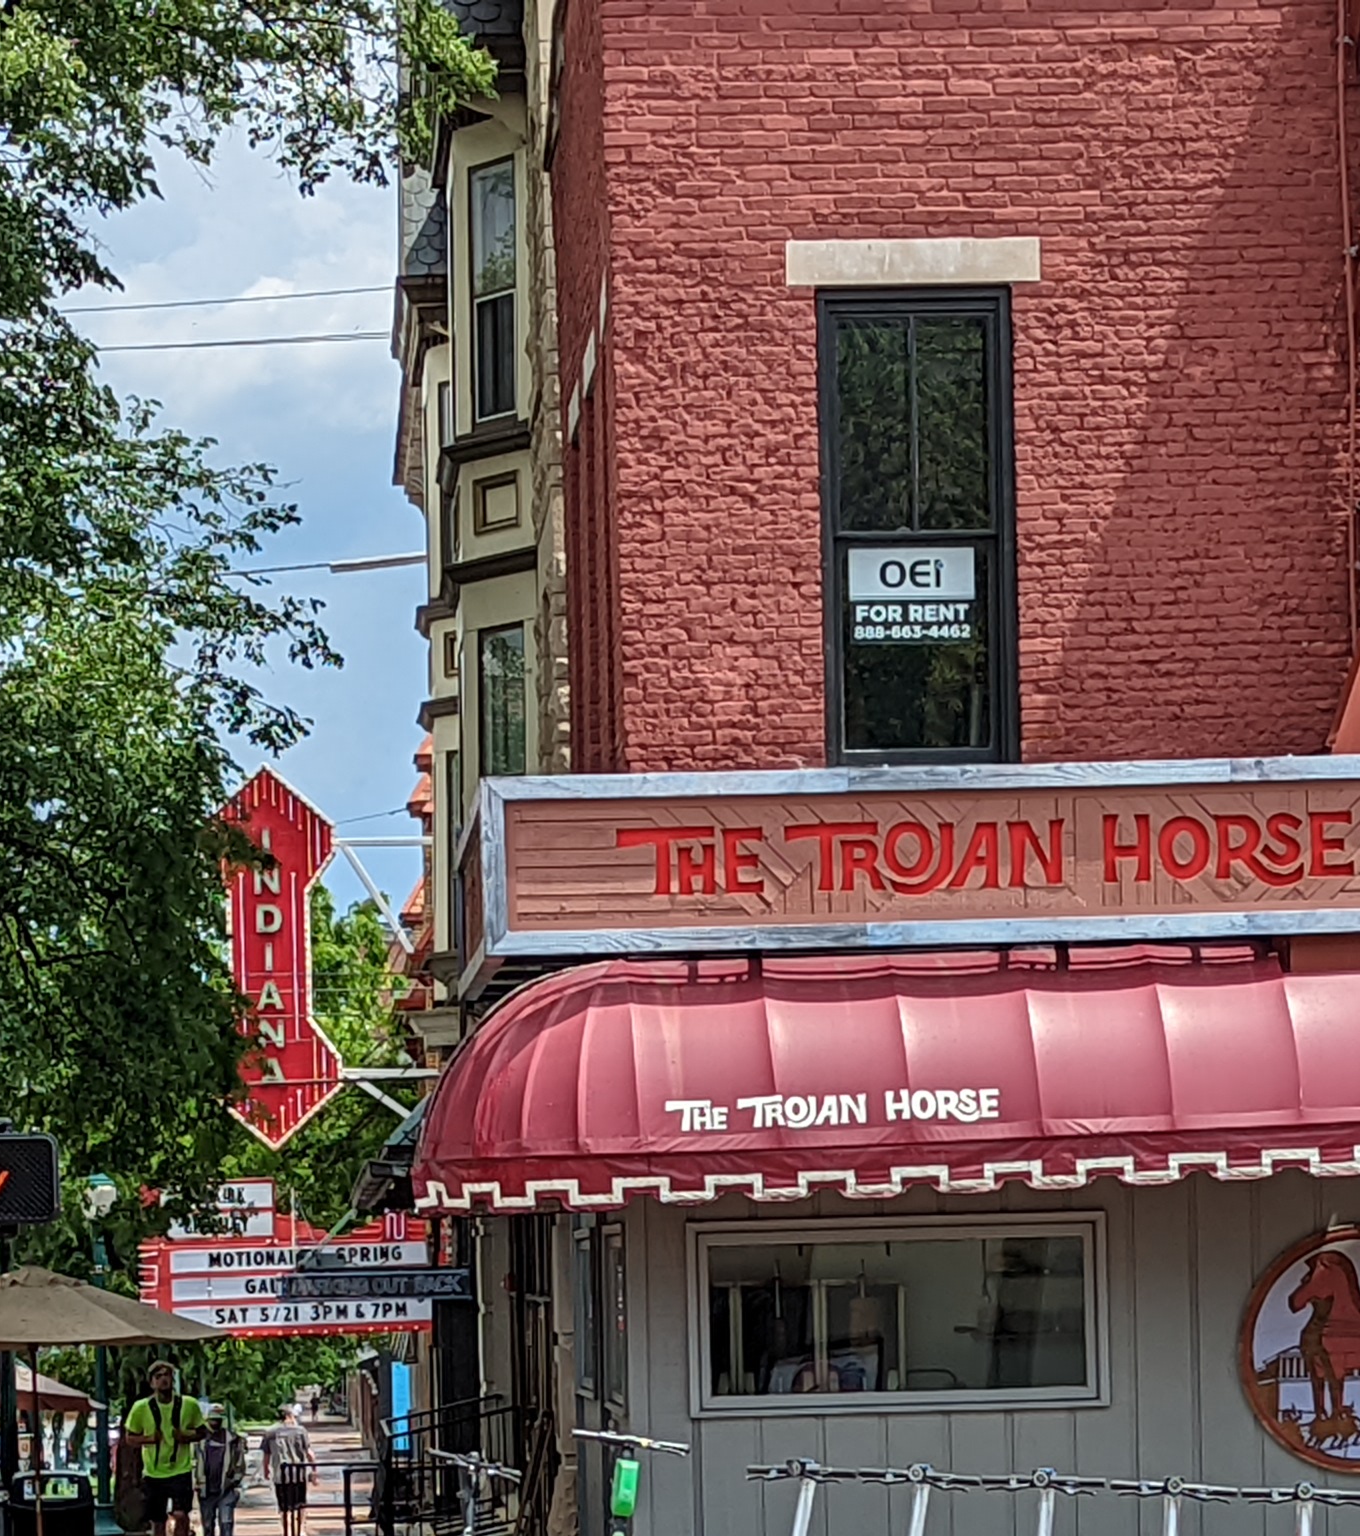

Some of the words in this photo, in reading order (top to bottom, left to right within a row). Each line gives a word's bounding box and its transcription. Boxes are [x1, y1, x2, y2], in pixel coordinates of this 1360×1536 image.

[854, 605, 903, 623] FOR
[908, 603, 970, 622] RENT
[616, 826, 765, 896] THE
[784, 816, 1066, 895] TROJAN
[1103, 810, 1357, 887] HORSE
[252, 827, 285, 1083] INDIANA
[665, 1099, 728, 1133] THE
[736, 1093, 869, 1130] TROJAN
[884, 1087, 1000, 1121] HORSE
[335, 1245, 402, 1265] SPRING
[244, 1278, 283, 1295] GAL
[371, 1277, 408, 1295] OUT
[215, 1308, 249, 1325] SAT
[260, 1306, 300, 1323] 5/21
[310, 1304, 349, 1322] 3PM
[355, 1303, 366, 1319] &
[370, 1301, 408, 1319] 7PM
